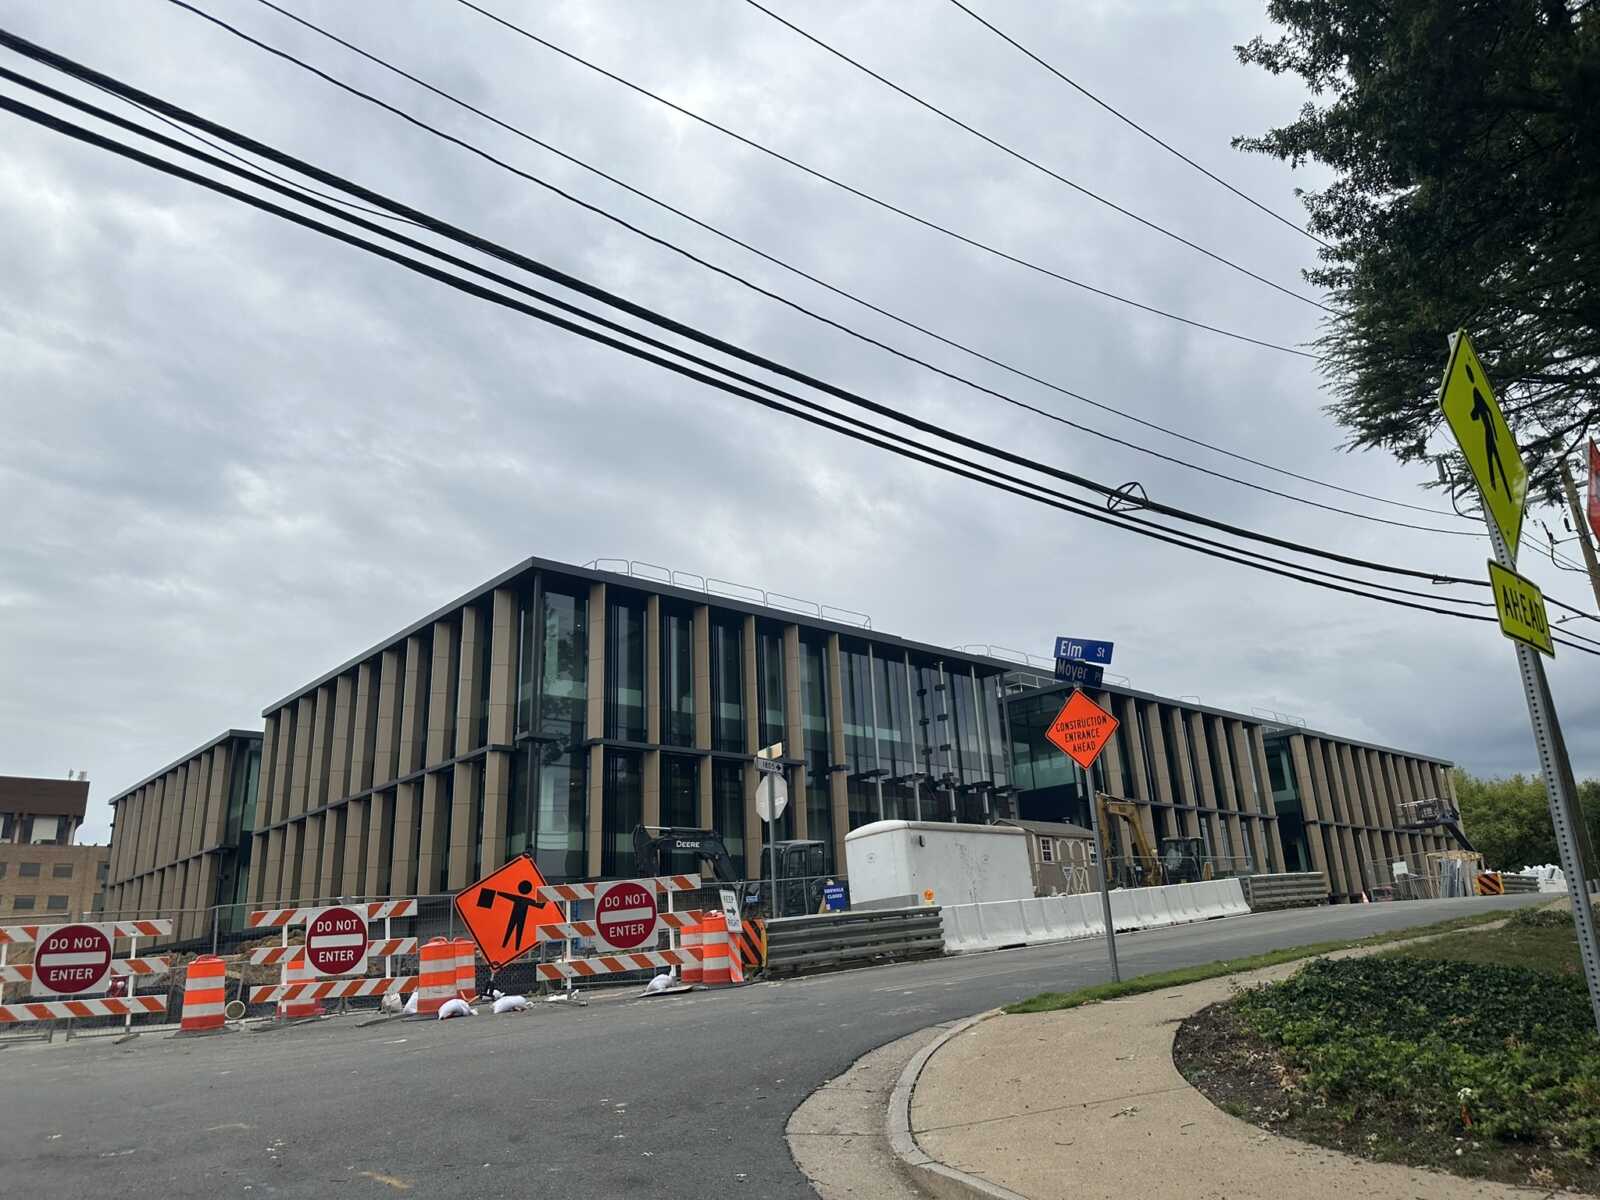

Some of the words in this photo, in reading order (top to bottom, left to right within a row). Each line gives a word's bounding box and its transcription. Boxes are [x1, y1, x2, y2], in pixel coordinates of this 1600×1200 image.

[1502, 584, 1545, 634] AHEAD
[1060, 640, 1082, 658] Elm
[1096, 646, 1105, 658] St
[1057, 658, 1089, 681] Moyer
[1055, 714, 1108, 733] CONSTRUCTION
[1064, 727, 1101, 743] ENTRANCE
[1072, 740, 1096, 753] AHEAD
[675, 840, 701, 848] DEERE
[604, 895, 620, 908] DO
[625, 892, 647, 906] NOT
[317, 921, 332, 933] DO
[336, 919, 358, 932] NOT
[609, 923, 645, 938] ENTER
[49, 938, 69, 950] DO
[73, 936, 101, 949] NOT
[319, 950, 354, 963] ENTER
[50, 968, 94, 982] ENTER
